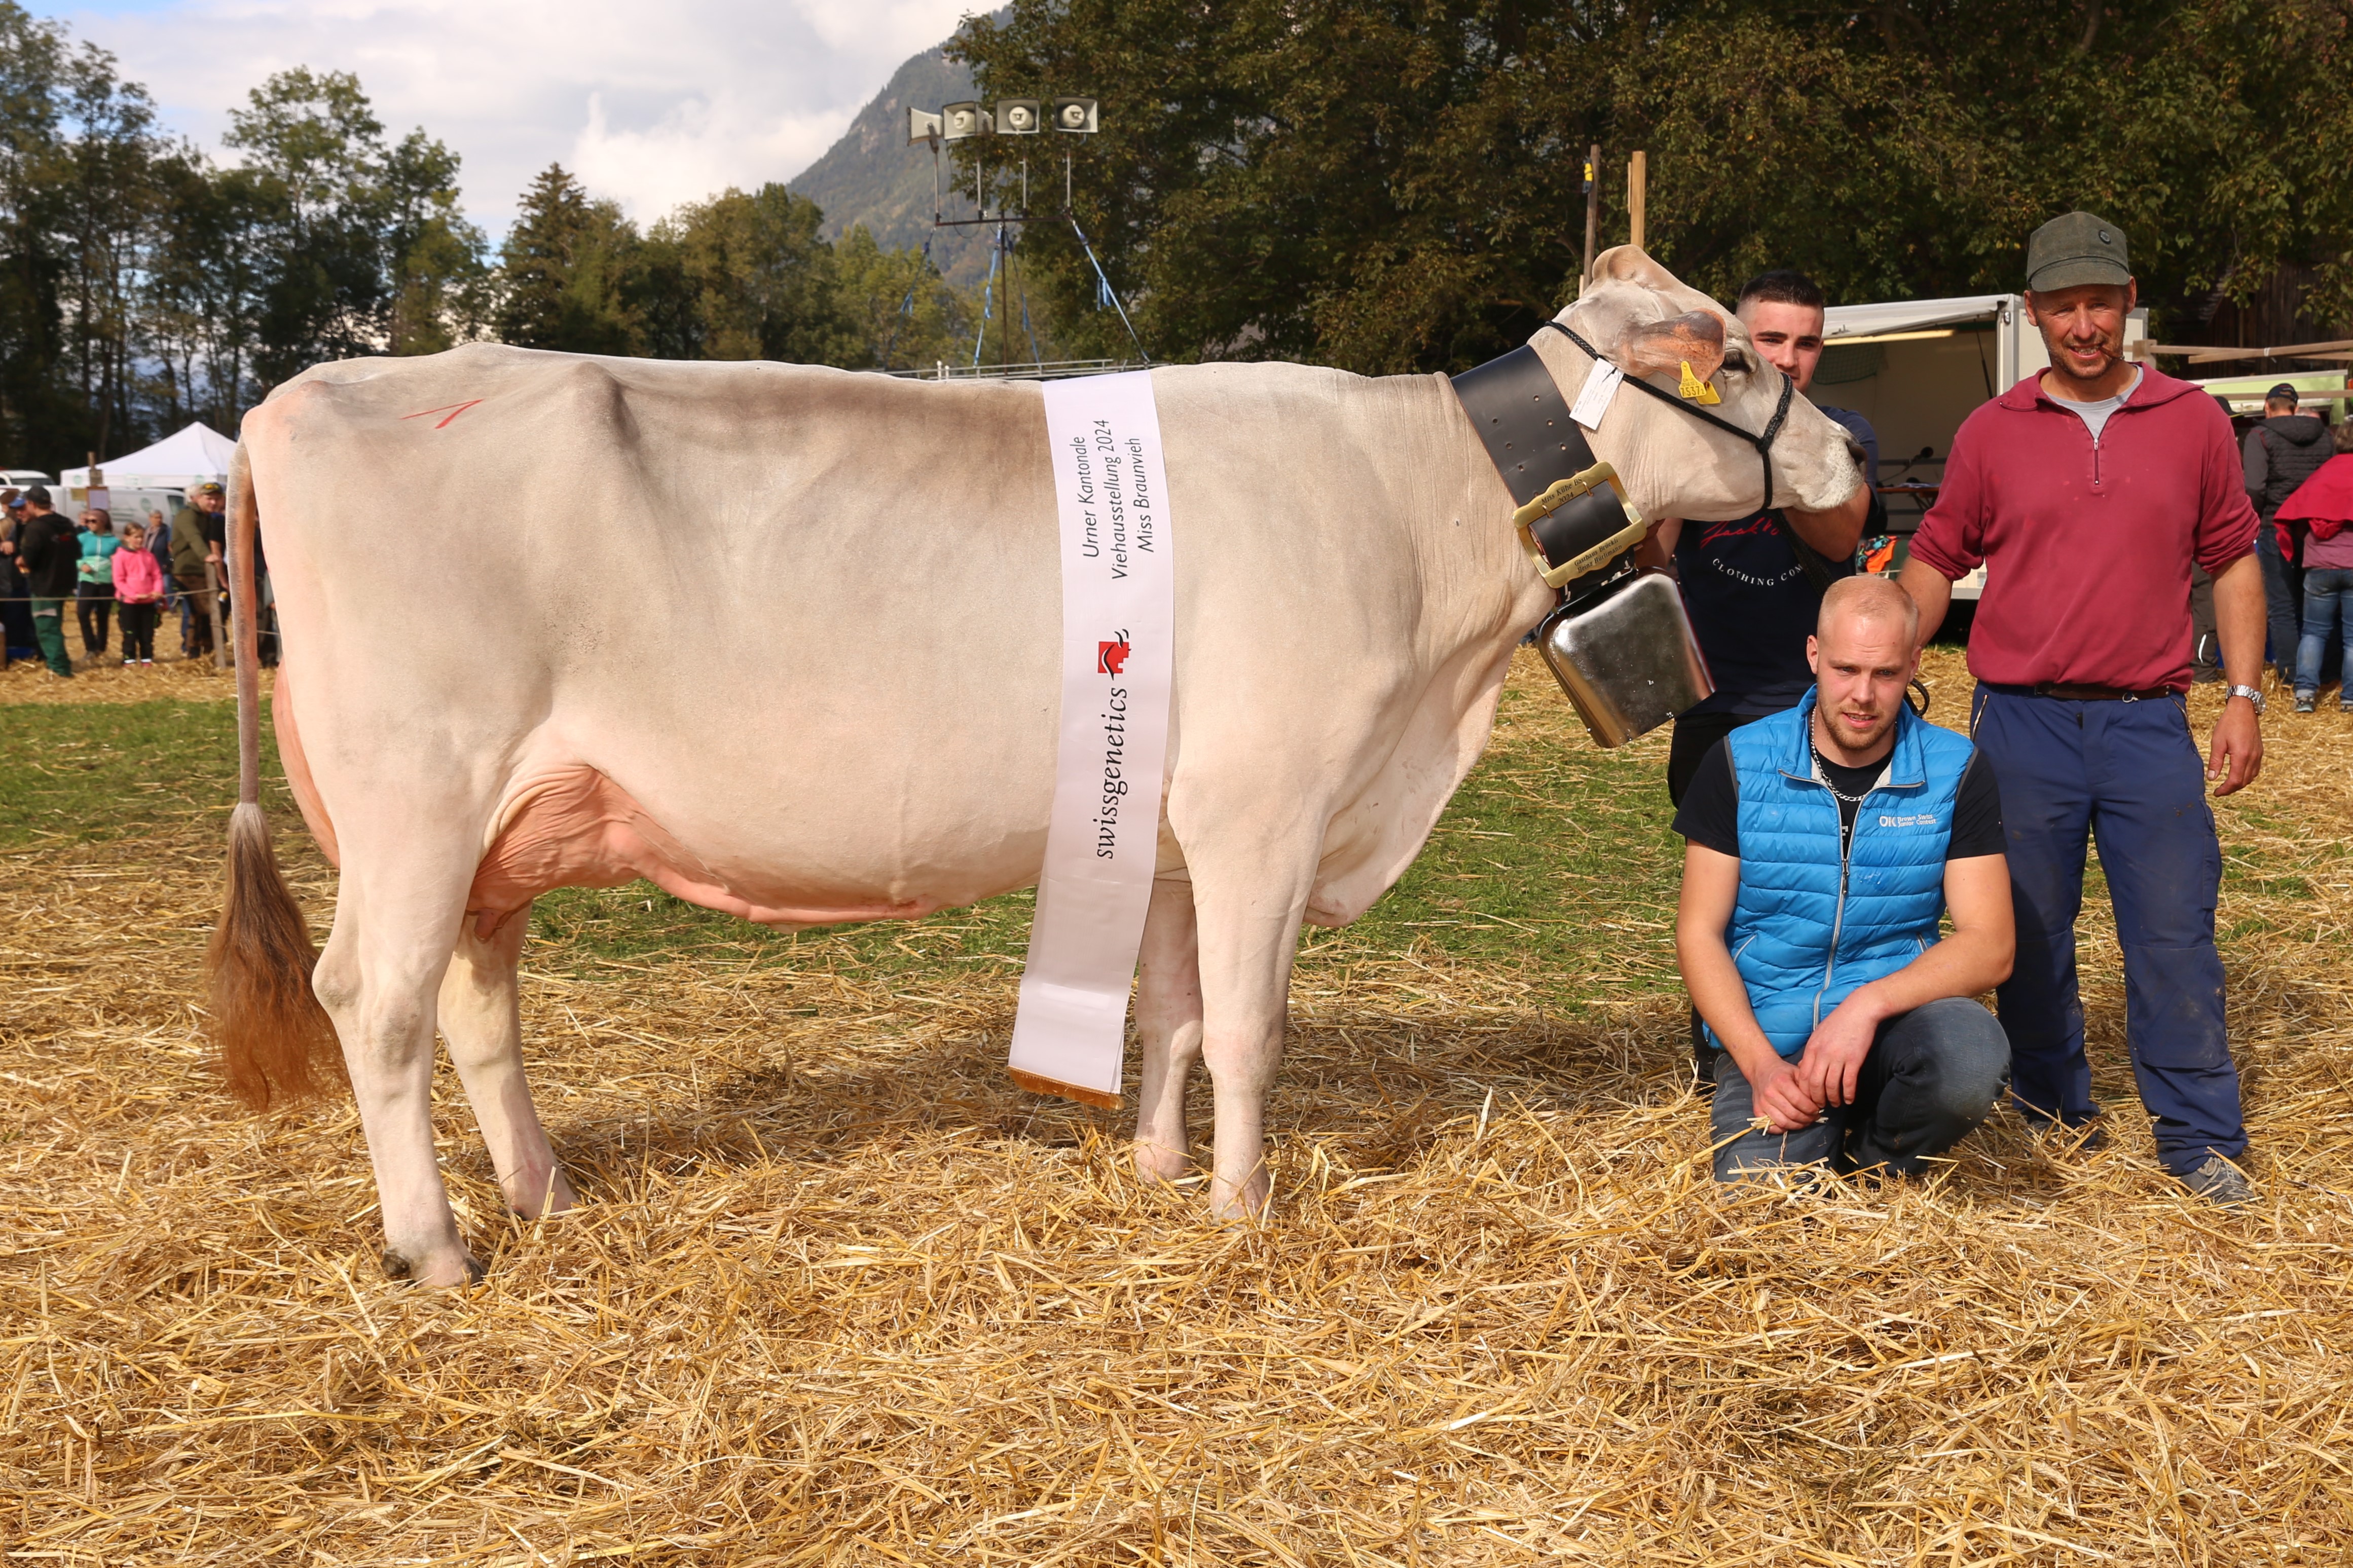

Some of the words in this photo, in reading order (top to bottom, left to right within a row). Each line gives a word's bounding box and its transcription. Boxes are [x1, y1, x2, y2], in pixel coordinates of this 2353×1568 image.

[1093, 420, 1115, 452] 2024
[1070, 436, 1095, 504] Kantonale
[1124, 438, 1150, 509] Braunvieh
[1541, 494, 1555, 505] Miss
[1556, 483, 1572, 496] Kühe
[1573, 476, 1583, 486] BS
[1557, 492, 1574, 506] 2024
[1083, 510, 1099, 557] Urner
[1103, 457, 1128, 579] Viehausstellung
[1136, 514, 1154, 553] Miss
[1574, 550, 1598, 567] Gasthaus
[1598, 538, 1619, 552] Brückli
[1576, 562, 1593, 574] Heinz
[1593, 544, 1623, 564] Hürlimann
[1712, 558, 1774, 586] CLOTHING
[1780, 563, 1803, 581] COM
[1092, 687, 1128, 860] swissgenetics
[1879, 815, 1897, 827] OK
